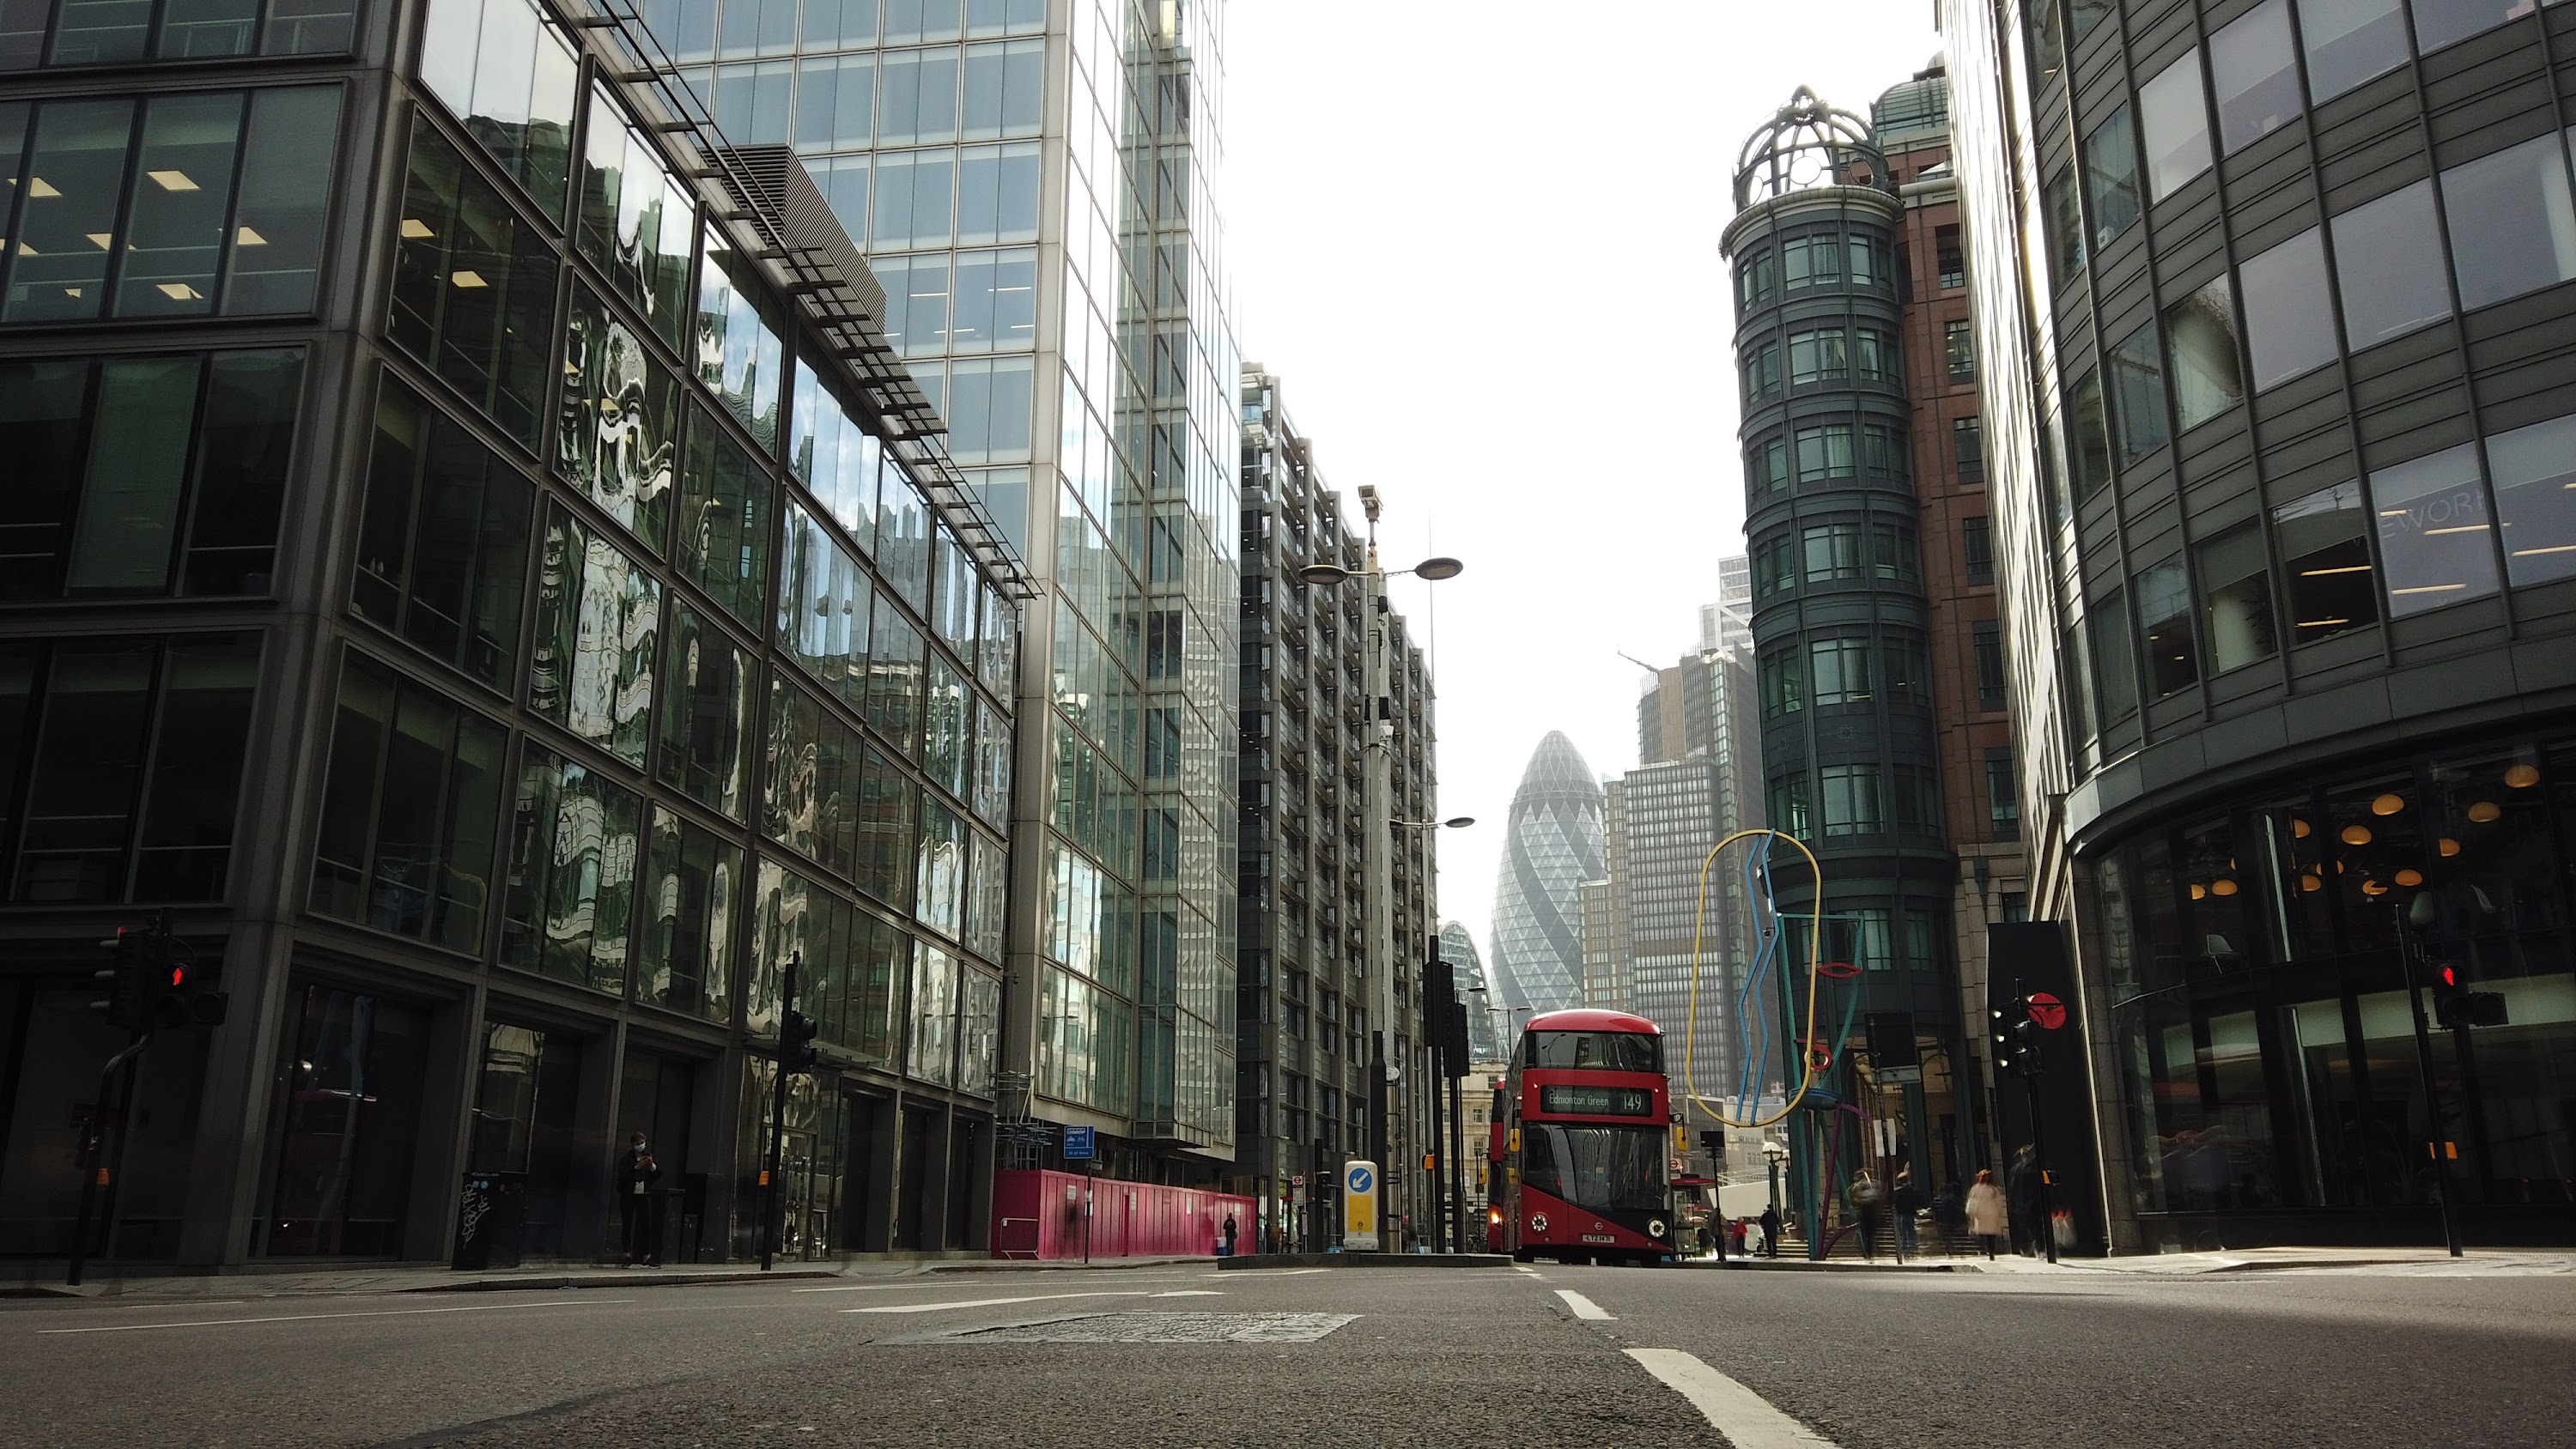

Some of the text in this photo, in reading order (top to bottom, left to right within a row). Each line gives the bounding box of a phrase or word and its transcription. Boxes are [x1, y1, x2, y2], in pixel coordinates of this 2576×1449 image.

[1549, 1094, 1642, 1111] Edmonton Green 149
